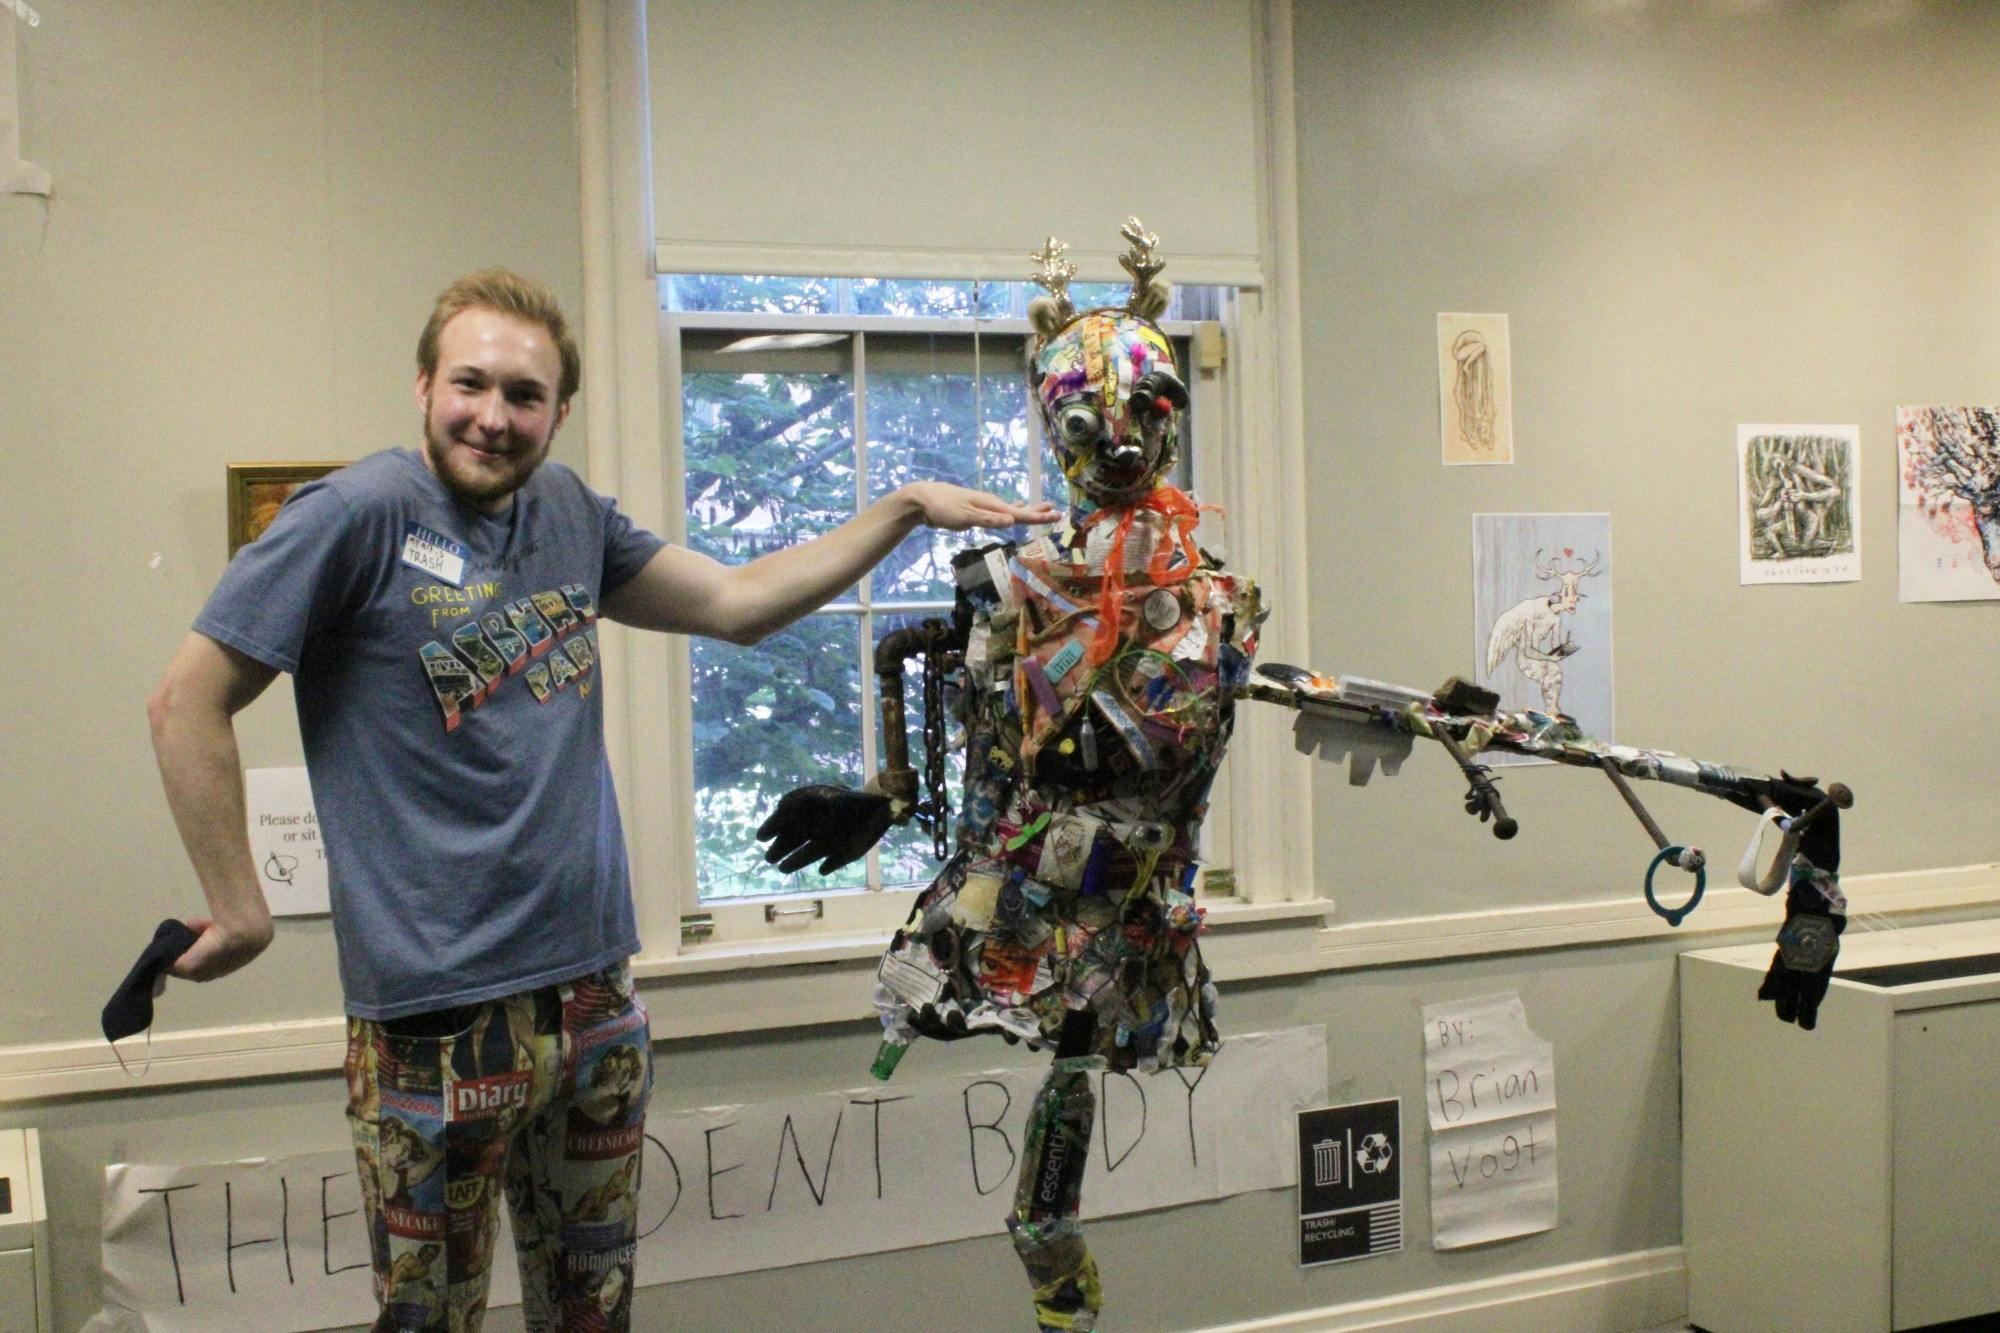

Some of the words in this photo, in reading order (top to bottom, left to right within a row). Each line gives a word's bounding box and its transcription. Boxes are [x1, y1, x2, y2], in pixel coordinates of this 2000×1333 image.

[416, 527, 460, 554] HELLO
[408, 548, 444, 572] TRASH
[432, 606, 470, 628] FROM
[259, 813, 300, 826] Please
[283, 832, 297, 842] or
[301, 828, 317, 841] sit
[1438, 1020, 1475, 1048] BY:
[458, 1081, 528, 1111] Diary
[1437, 1067, 1538, 1122] Brian
[1041, 1128, 1067, 1202] essenti
[1448, 1126, 1538, 1189] Vogt
[138, 1171, 371, 1305] THE
[963, 1040, 1225, 1195] BDY
[1304, 1217, 1337, 1230] TRASH/
[1304, 1226, 1355, 1242] RECYCLING
